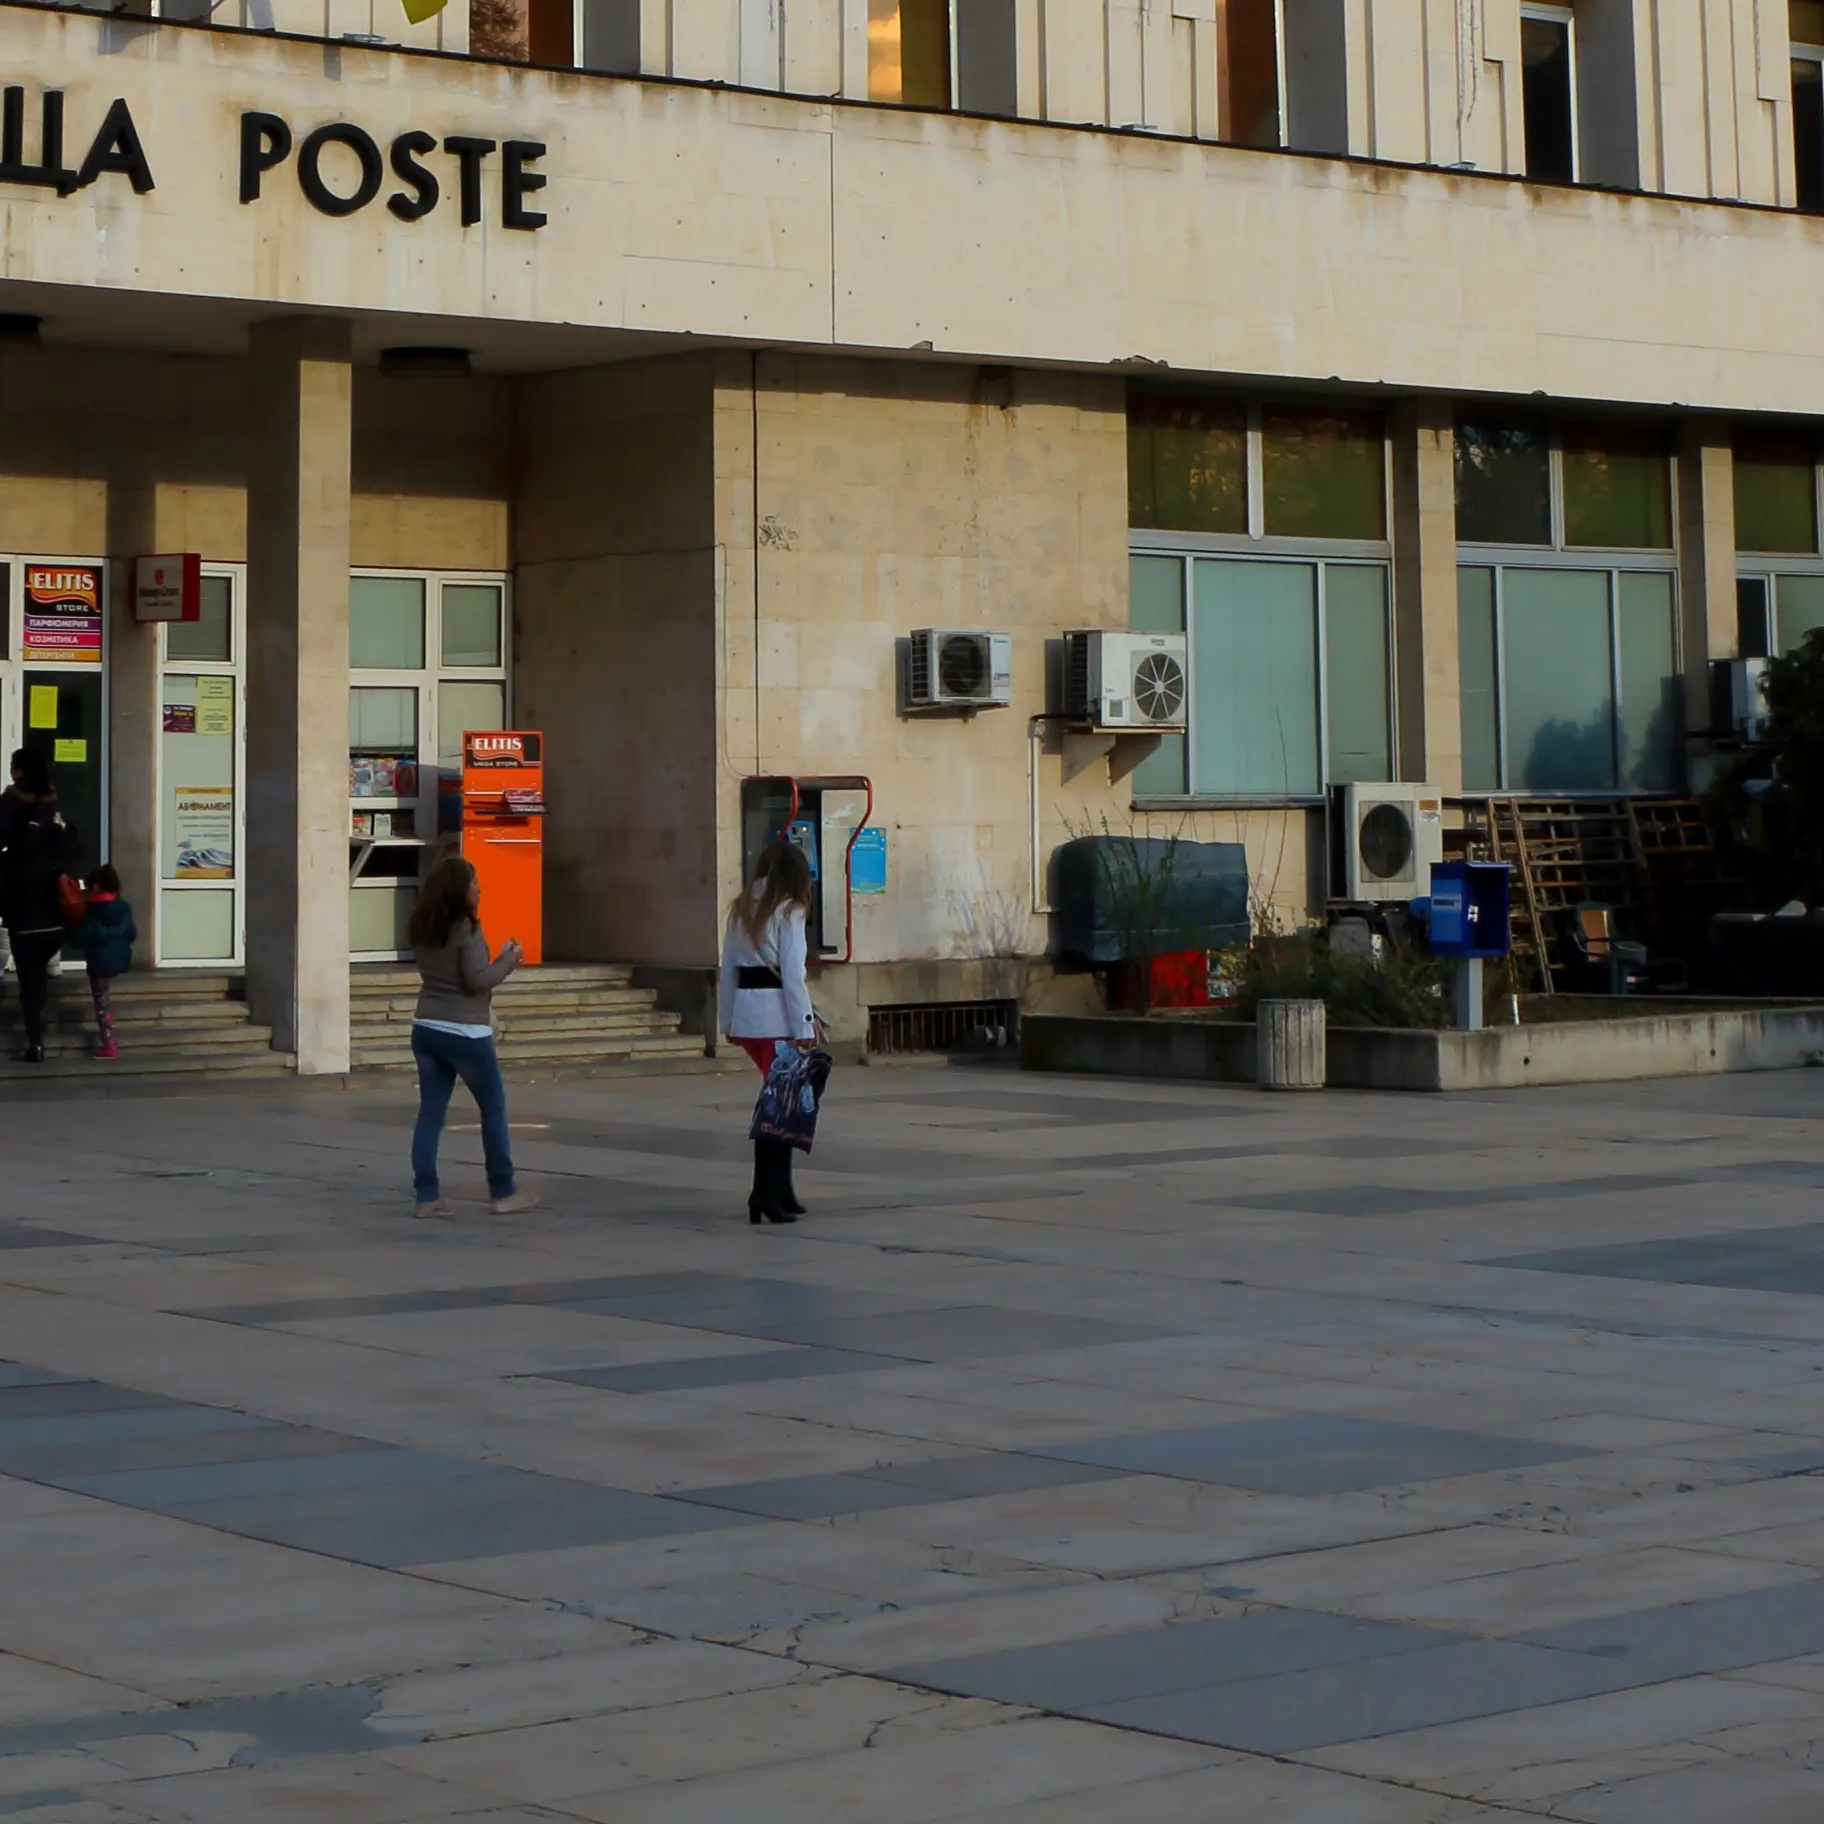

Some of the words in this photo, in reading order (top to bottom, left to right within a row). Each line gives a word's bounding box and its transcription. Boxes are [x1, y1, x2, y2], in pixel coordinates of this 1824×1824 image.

[238, 111, 548, 232] POSTE
[33, 572, 94, 590] ELITIS
[56, 604, 89, 612] STORE
[475, 737, 523, 751] ELITIS
